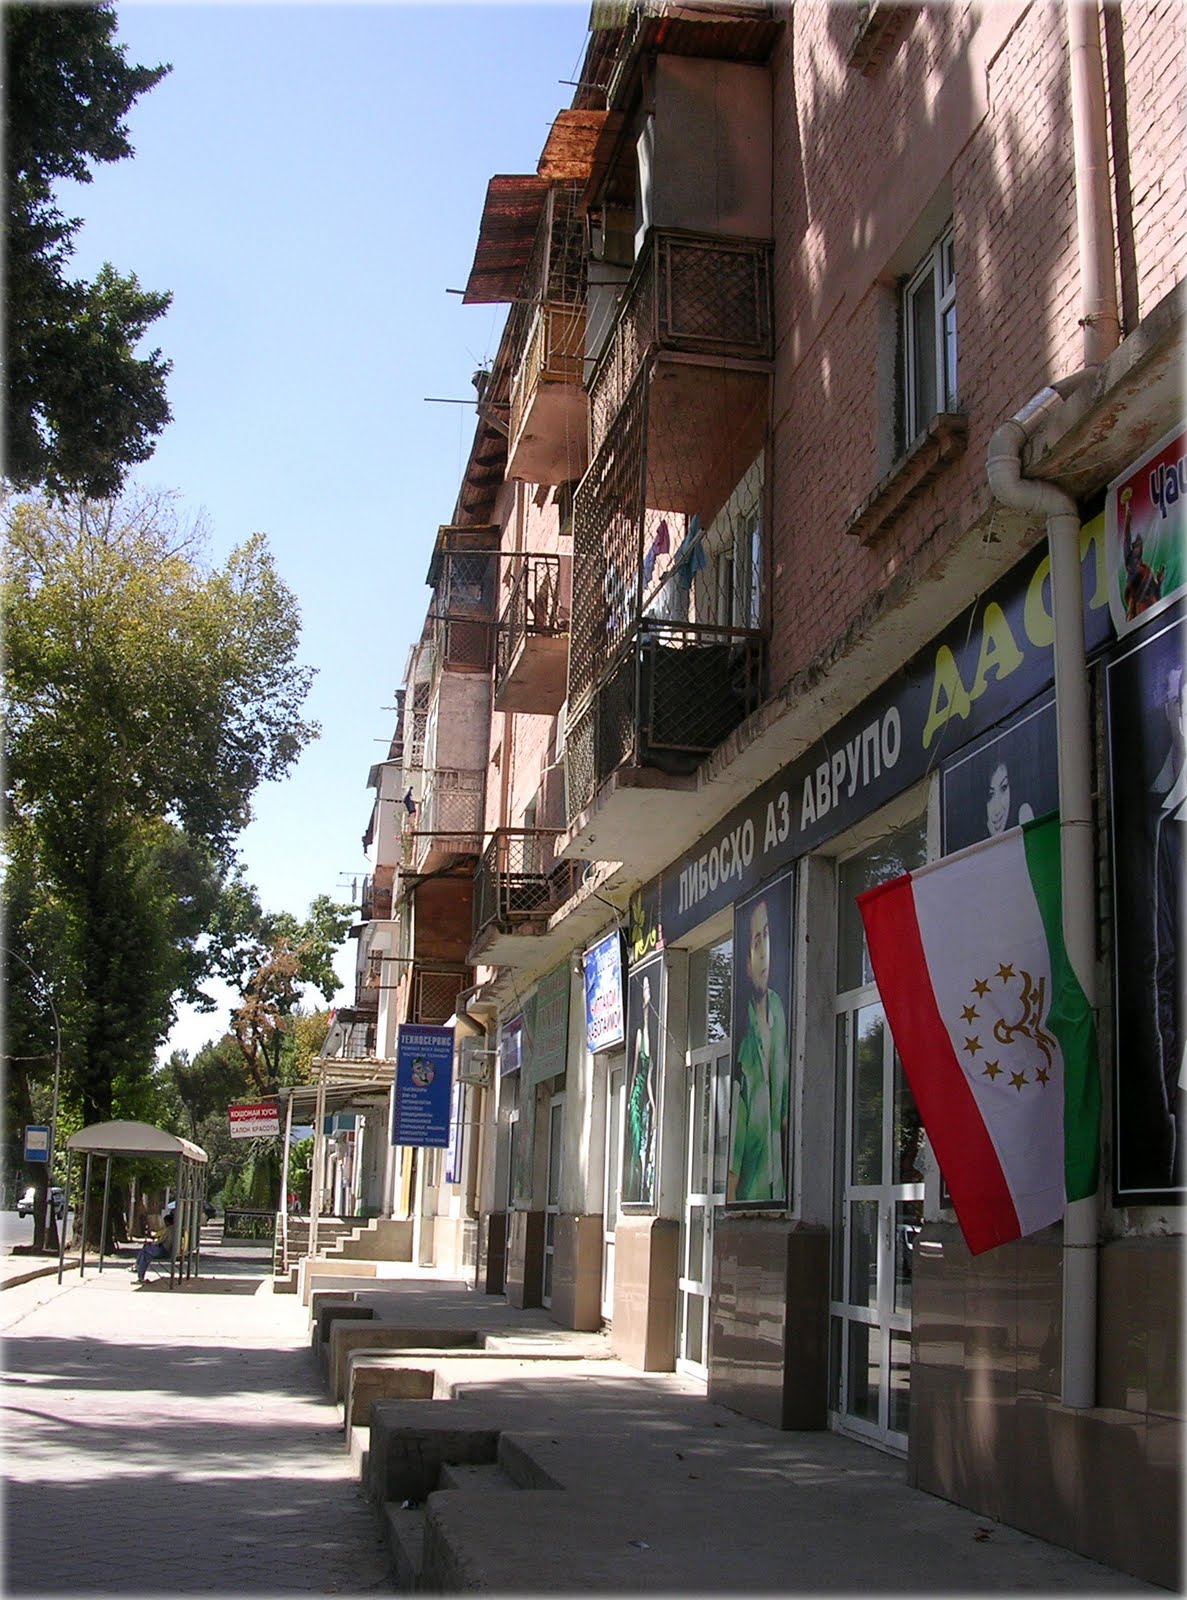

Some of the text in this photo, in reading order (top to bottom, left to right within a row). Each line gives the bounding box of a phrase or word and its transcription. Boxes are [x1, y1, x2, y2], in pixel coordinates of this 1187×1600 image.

[678, 706, 901, 915] ЛИБОСҲО АЗ АВРУПО
[401, 1035, 452, 1046] ТЕХНОСЕРВИС
